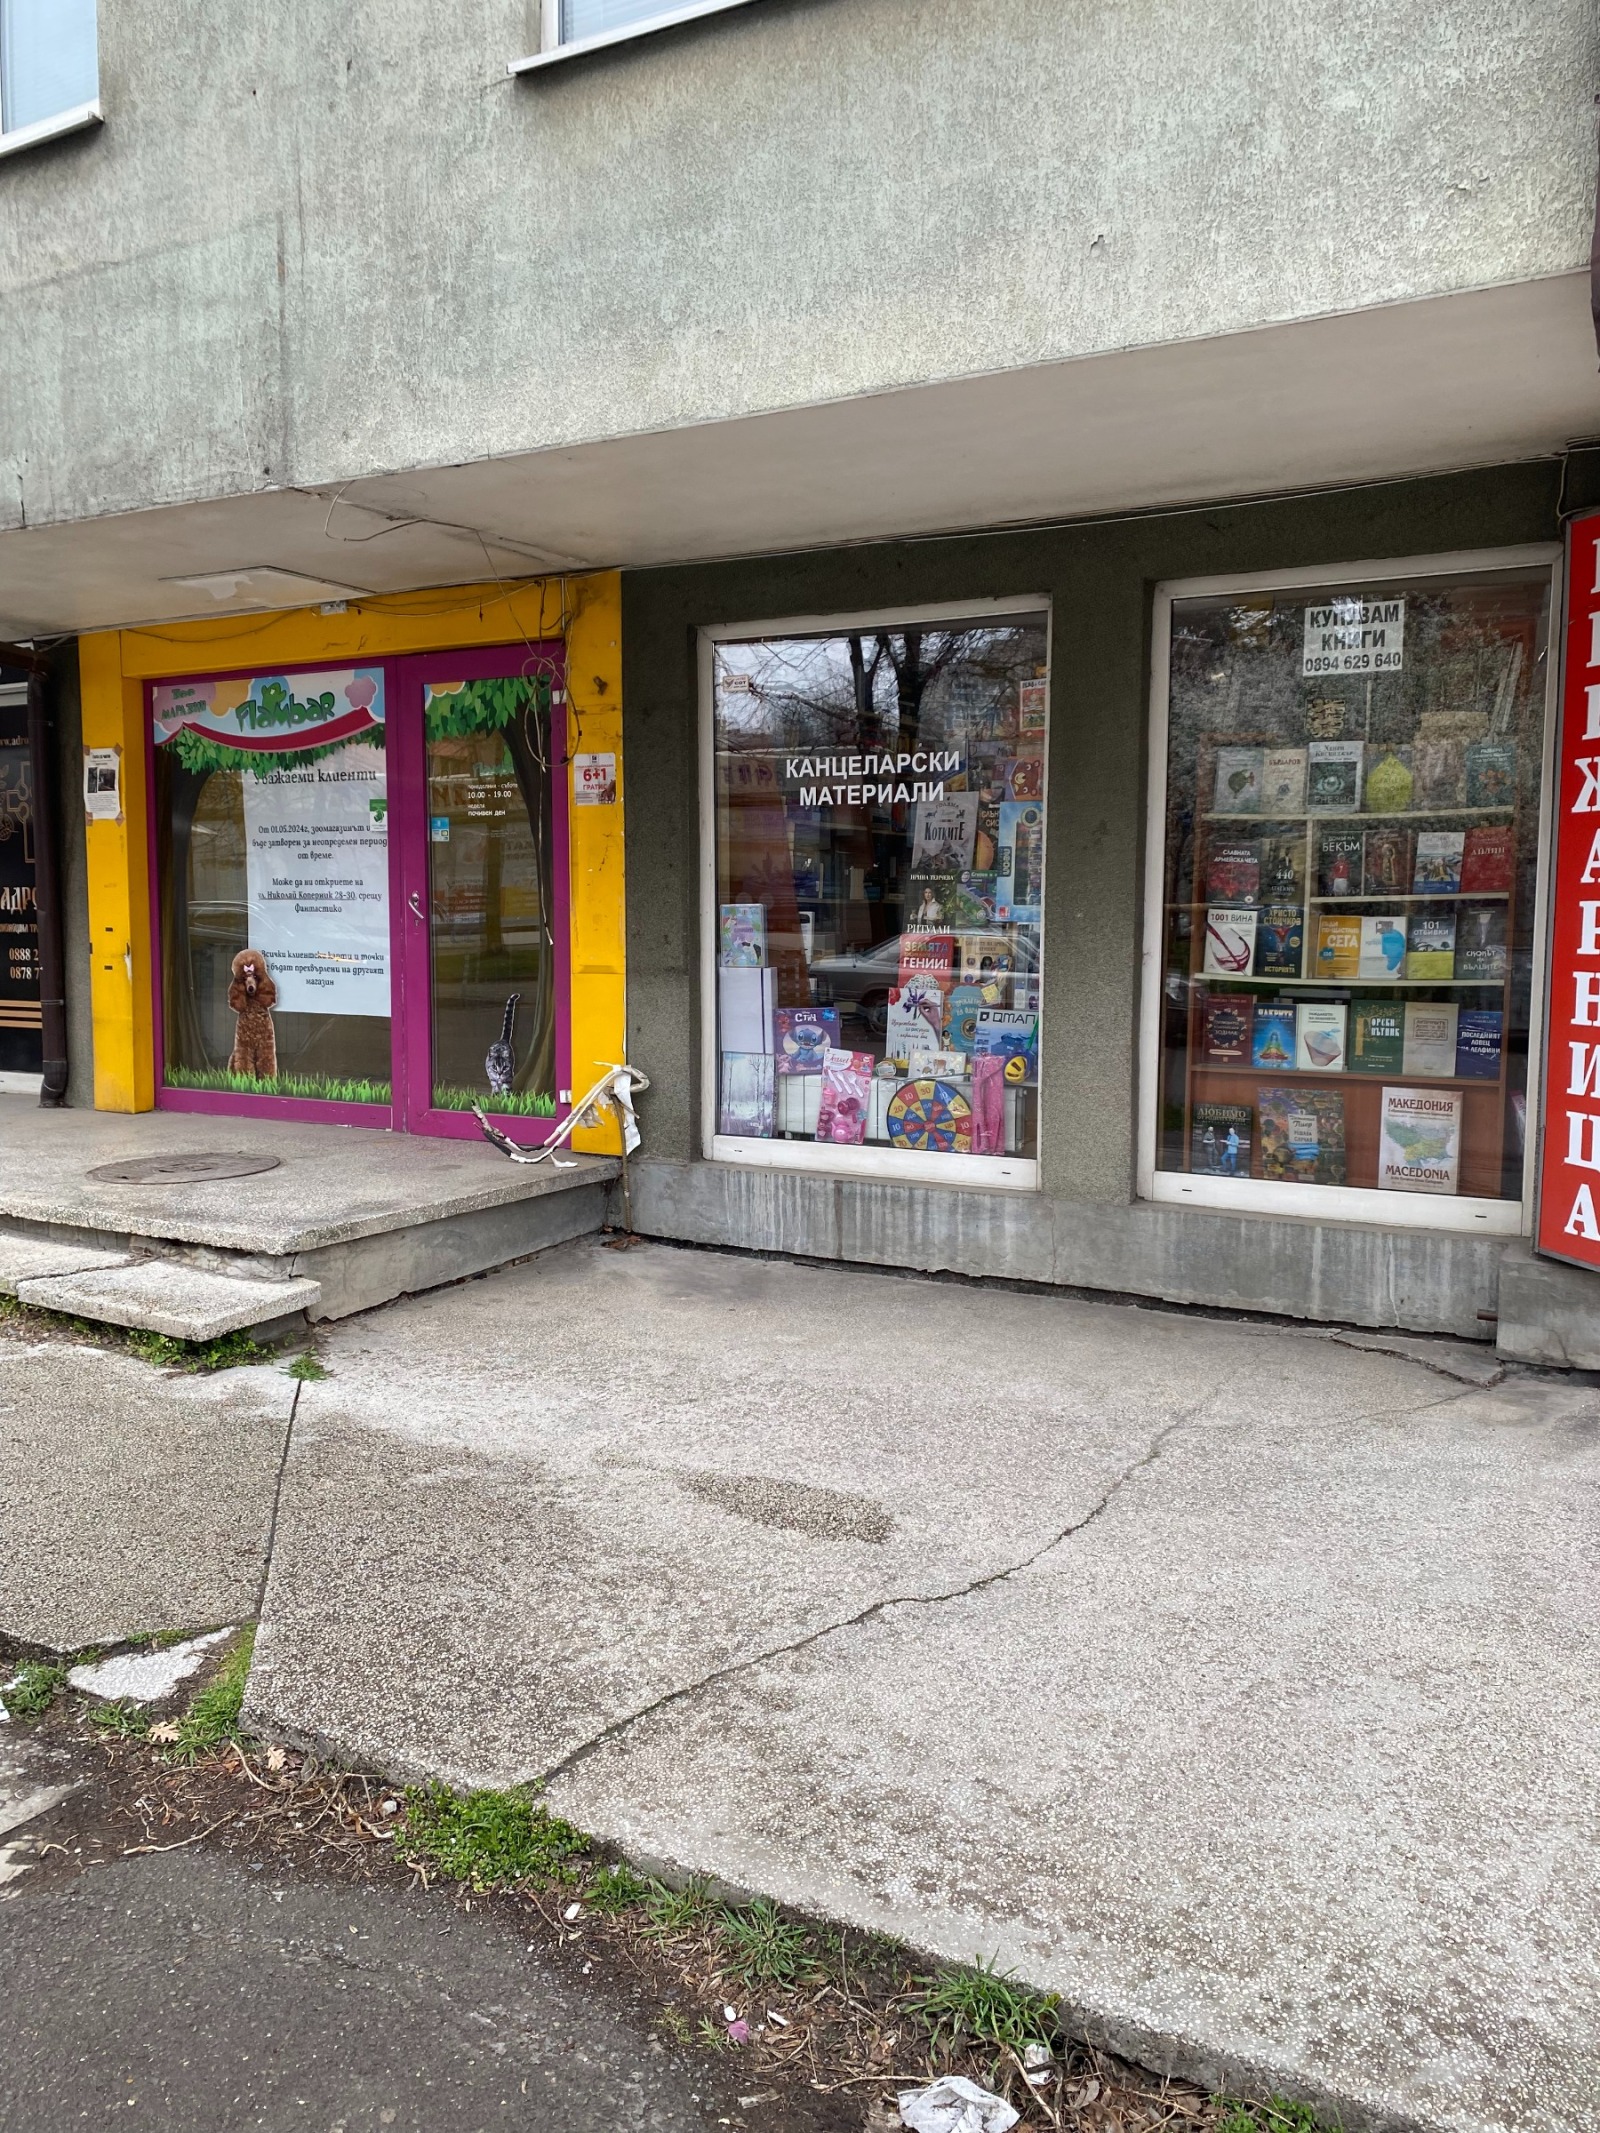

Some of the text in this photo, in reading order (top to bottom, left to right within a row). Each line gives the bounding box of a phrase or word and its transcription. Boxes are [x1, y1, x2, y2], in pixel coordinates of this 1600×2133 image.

[1305, 652, 1401, 672] 0894 629 640
[786, 751, 960, 779] КАНЦЕЛАРСКИ
[254, 769, 377, 785] Уважаеми клиенти
[583, 768, 606, 781] 6+1
[467, 791, 486, 799] 10.00
[493, 790, 512, 798] 19.00
[800, 781, 945, 806] МАТЕРИАЛИ
[258, 826, 269, 834] От
[311, 825, 365, 834] зоомагазинът
[252, 837, 387, 849] бъде затворен за неопределен период
[1322, 842, 1361, 852] БЕКЪМ
[310, 851, 334, 861] време.
[1276, 869, 1294, 880] 440
[272, 878, 293, 886] Може
[294, 880, 303, 888] да
[314, 878, 353, 888] откриете
[267, 890, 297, 899] Николай
[298, 891, 333, 901] Коперник
[358, 892, 382, 902] срещу
[295, 903, 342, 913] Фантастико
[1269, 909, 1297, 917] ХРИСТО
[1211, 913, 1253, 922] 1001 ВИНА
[907, 924, 950, 935] РИТУАЛИ
[1422, 920, 1440, 930] 101
[1327, 935, 1359, 948] СЕГА
[905, 941, 948, 954] ЗЕМЯТА
[9, 948, 31, 961] 0888
[261, 950, 286, 958] Всички
[271, 962, 293, 973] бъдат
[295, 963, 340, 974] прехвърлени
[353, 967, 384, 976] другият
[903, 957, 948, 970] ГЕНИИ!
[10, 966, 32, 980] 0878
[306, 978, 334, 987] магазин
[921, 1087, 931, 1095] 30
[904, 1093, 914, 1101] 10
[893, 1105, 904, 1113] 20
[1388, 1098, 1453, 1112] МАКЕДОНИЯ
[892, 1123, 901, 1132] 10
[960, 1121, 970, 1130] 10
[1385, 1165, 1450, 1180] MACEDONIA
